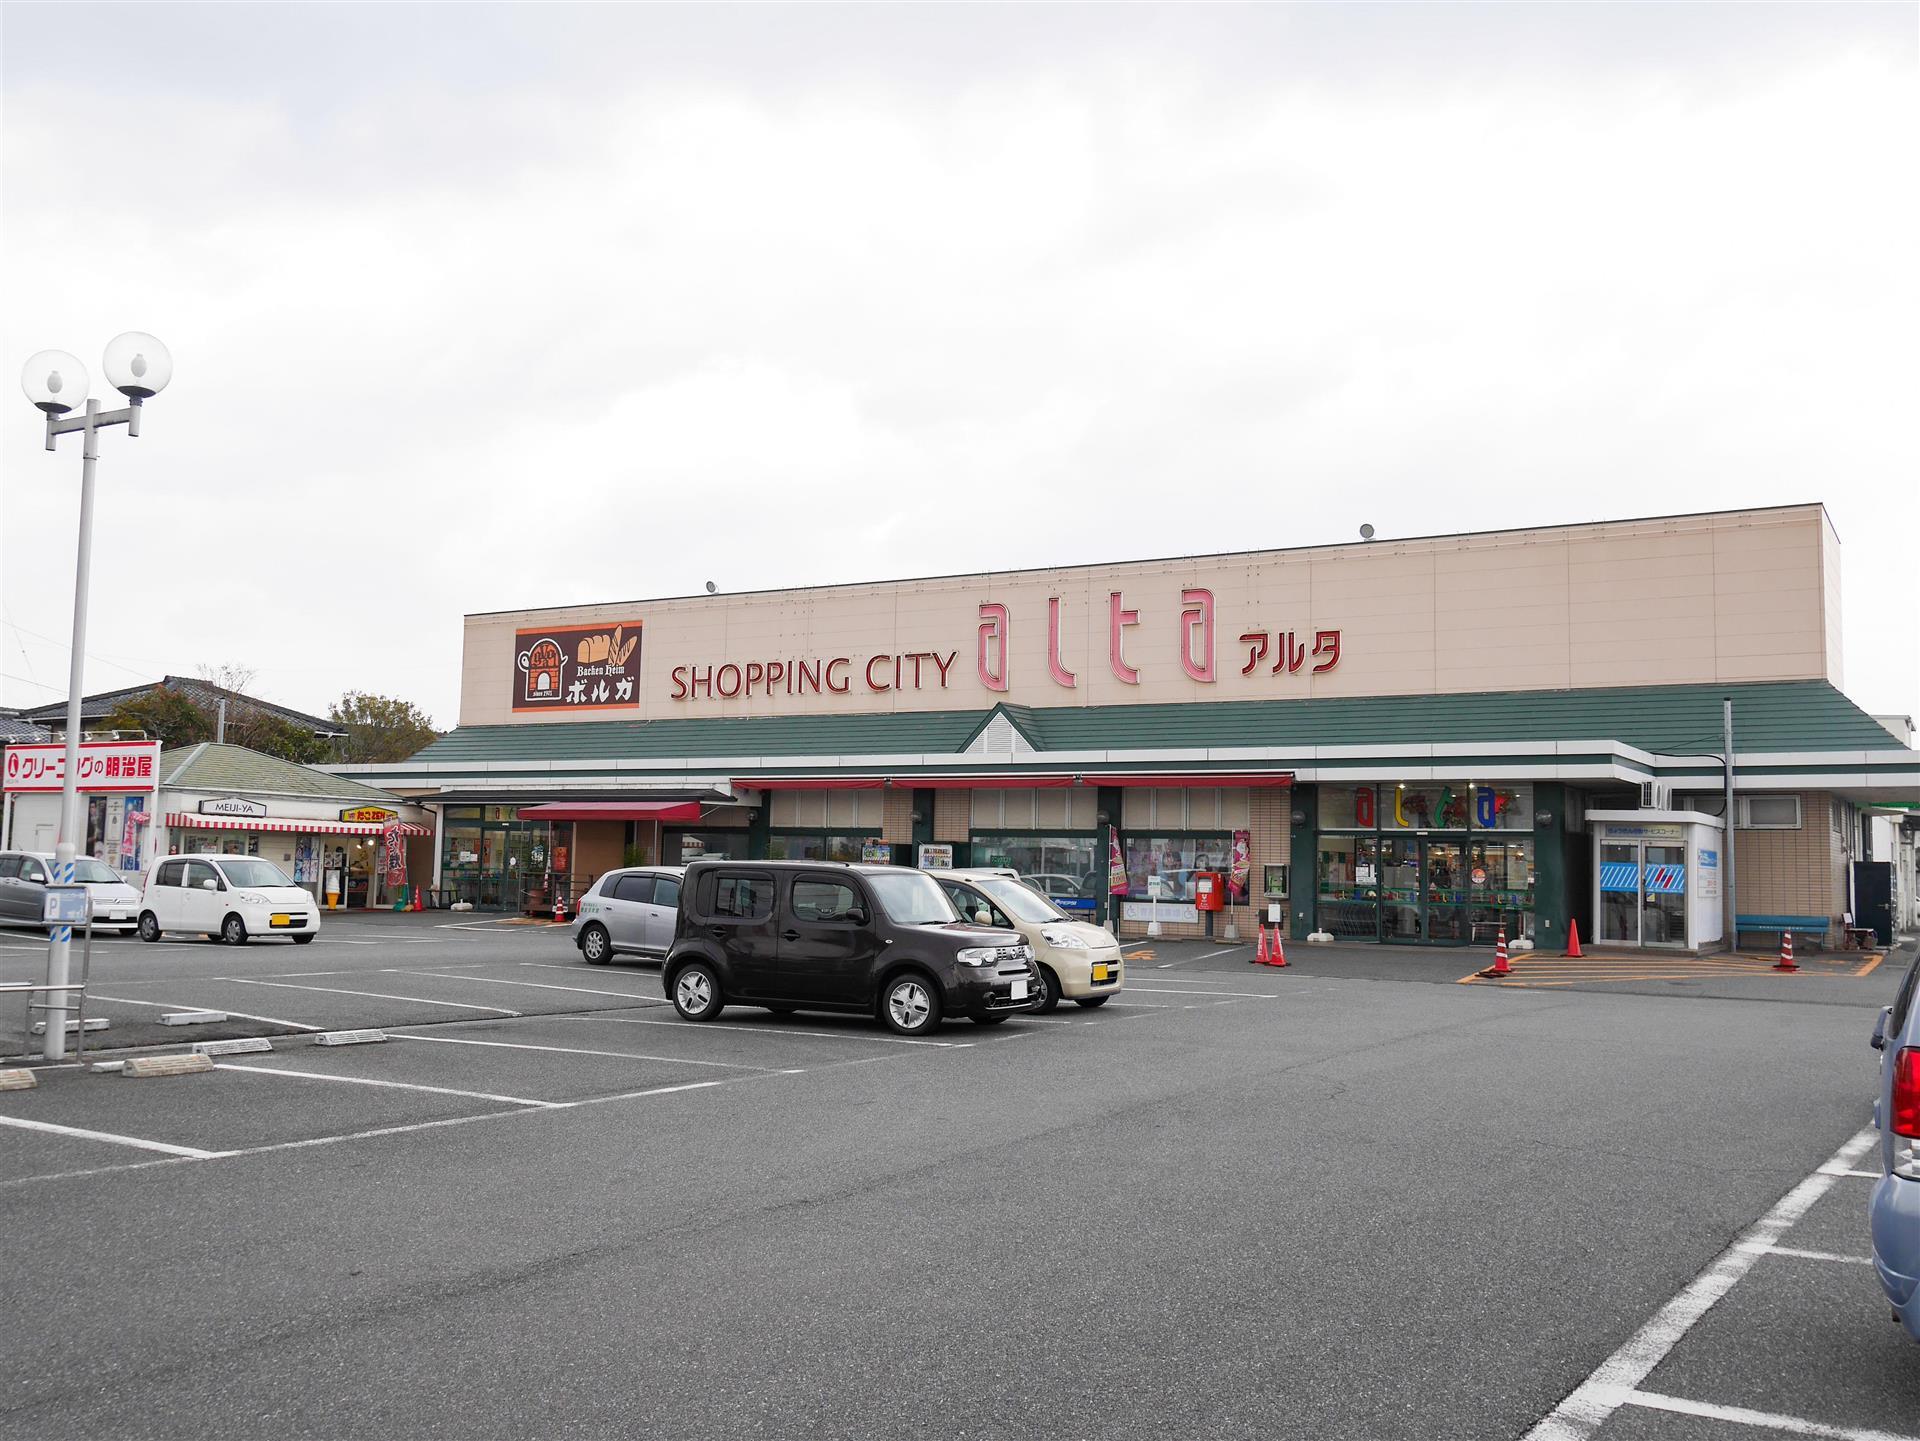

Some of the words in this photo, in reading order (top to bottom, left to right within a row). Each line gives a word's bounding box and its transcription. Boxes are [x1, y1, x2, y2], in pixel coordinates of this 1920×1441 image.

[978, 588, 1216, 691] alta
[1239, 629, 1342, 676] アルタ
[565, 676, 635, 704] ボルガ
[670, 656, 852, 701] SHOPPING
[866, 650, 959, 692] CITY
[22, 755, 153, 779] クリーニグの明治屋
[215, 803, 254, 813] MEIJI-YA
[1355, 786, 1496, 828] alta
[49, 897, 58, 915] P
